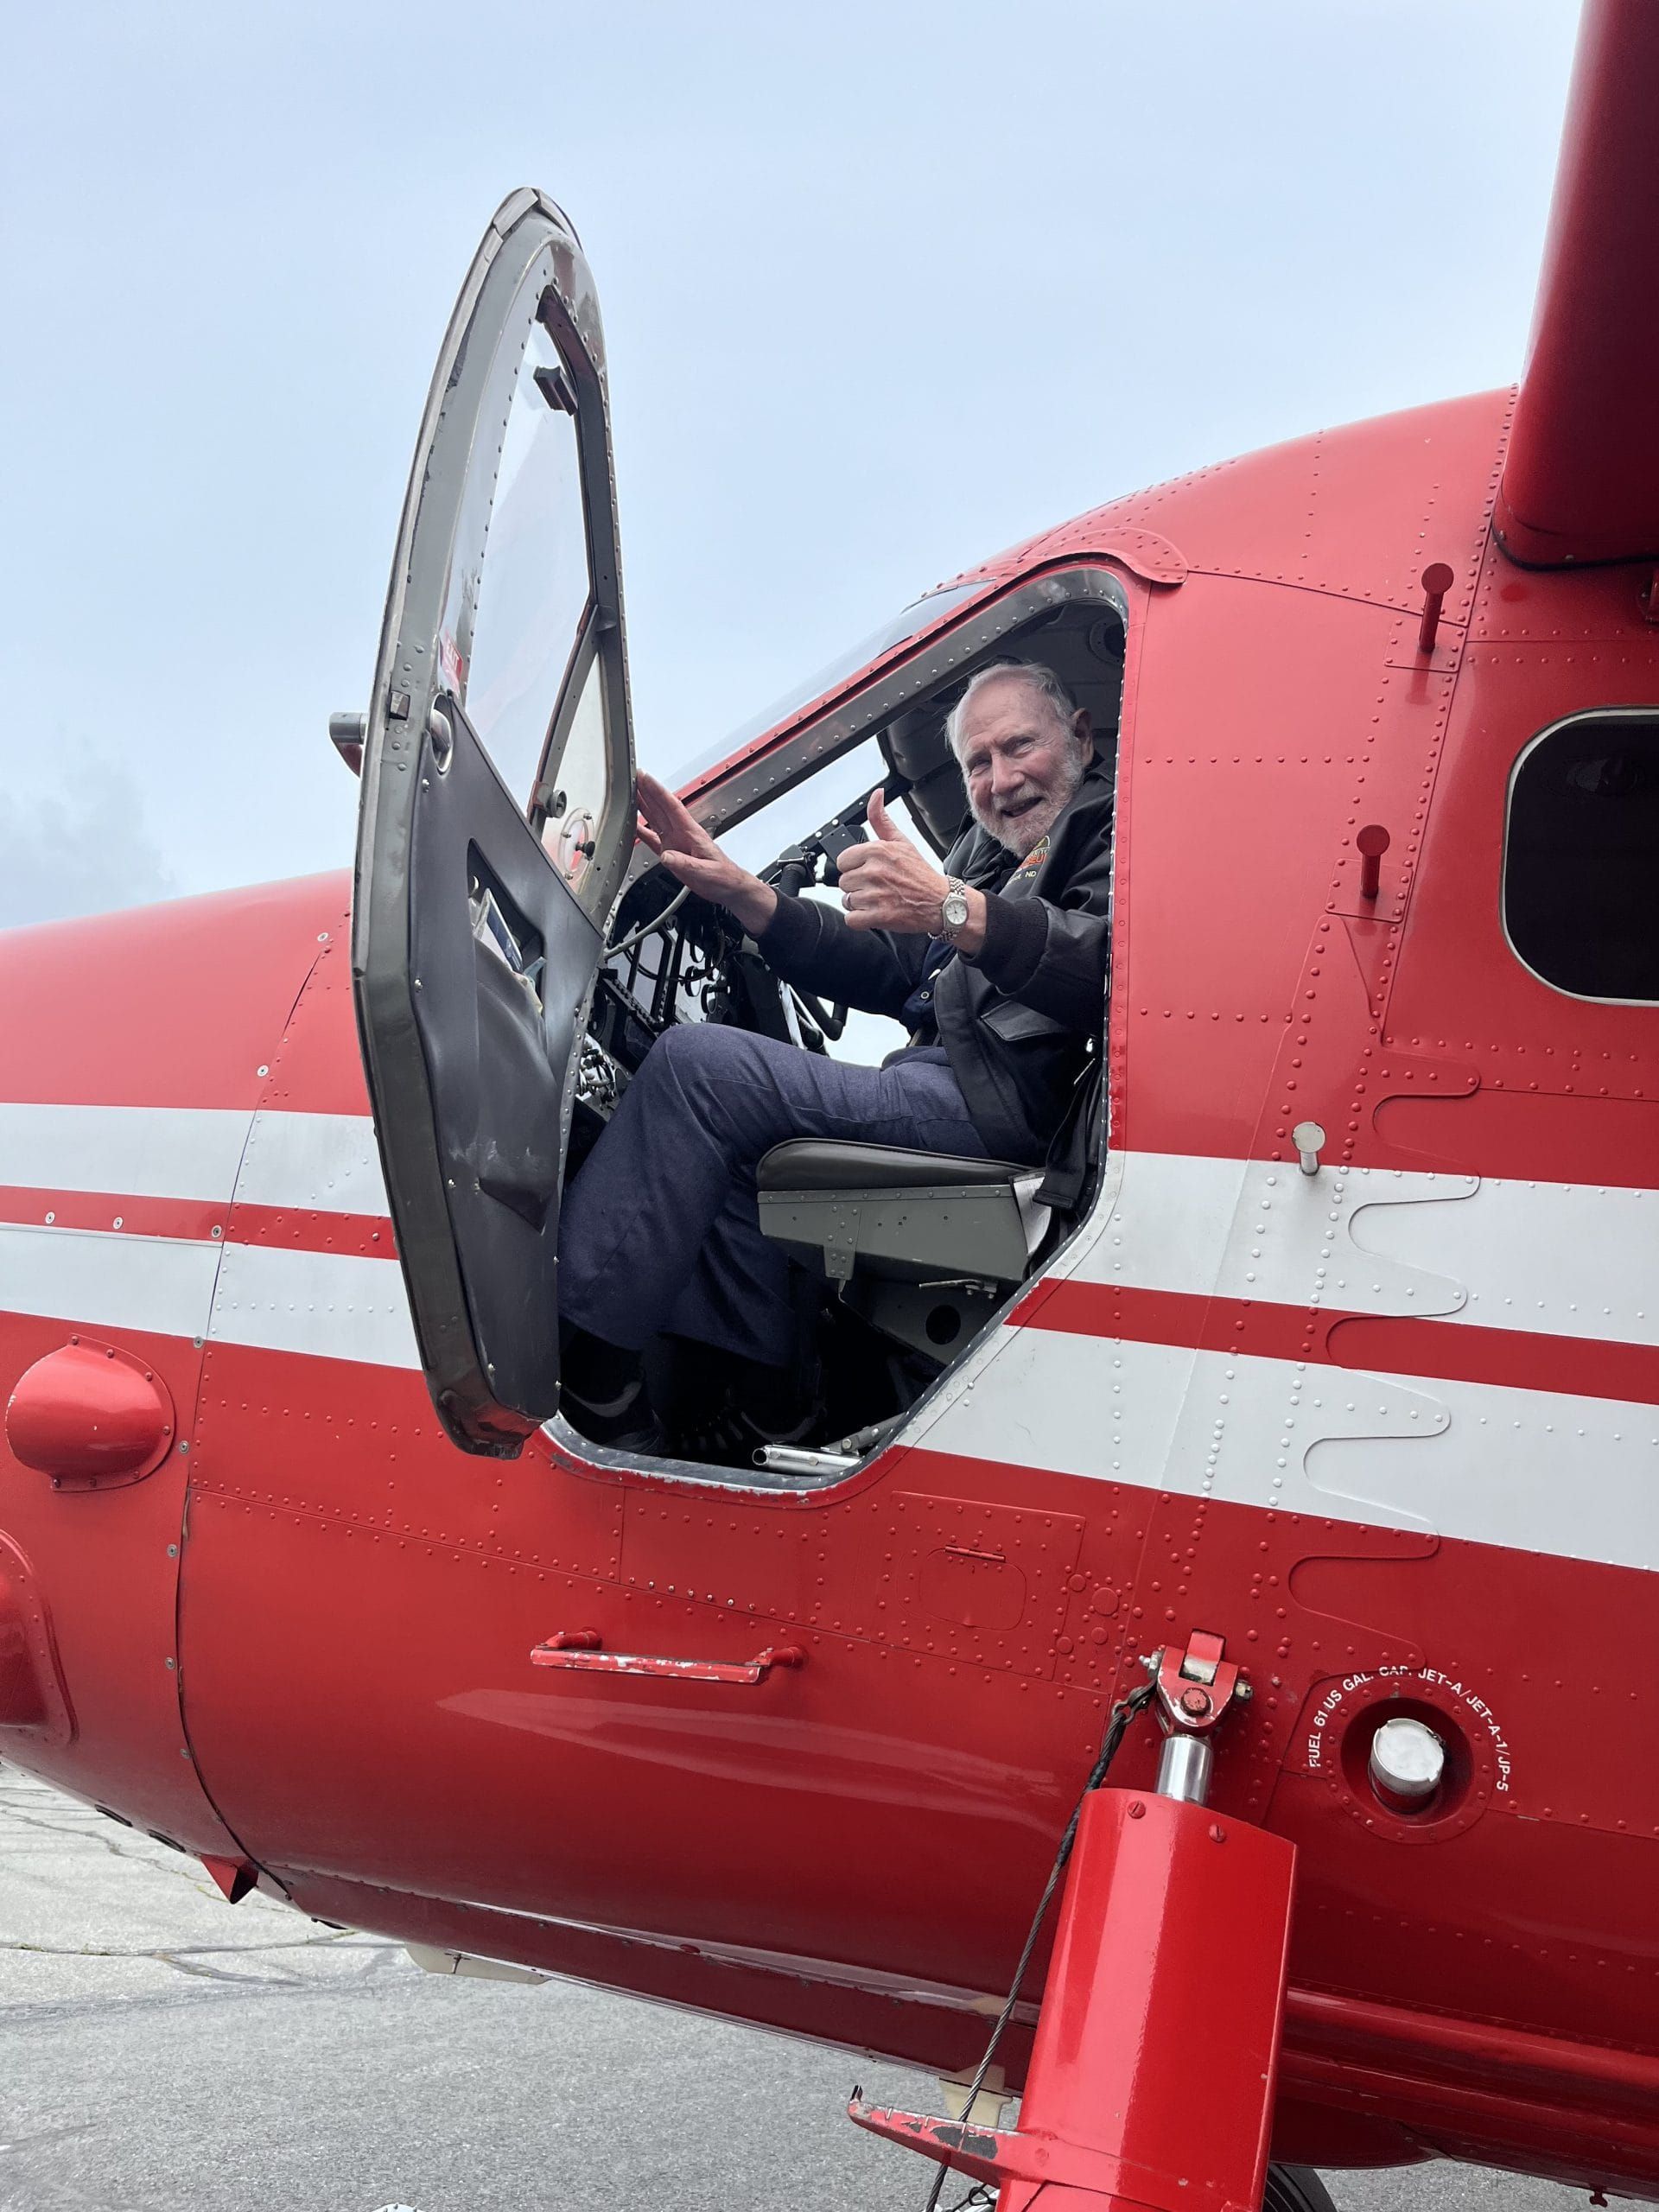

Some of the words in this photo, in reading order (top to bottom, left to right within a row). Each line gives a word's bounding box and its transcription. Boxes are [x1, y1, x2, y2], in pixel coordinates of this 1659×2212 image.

[1378, 1665, 1413, 1678] CAP.
[1342, 1672, 1375, 1692] GAL.
[1323, 1689, 1343, 1710] US
[1313, 1710, 1329, 1727] 61
[1308, 1732, 1322, 1768] FUEL
